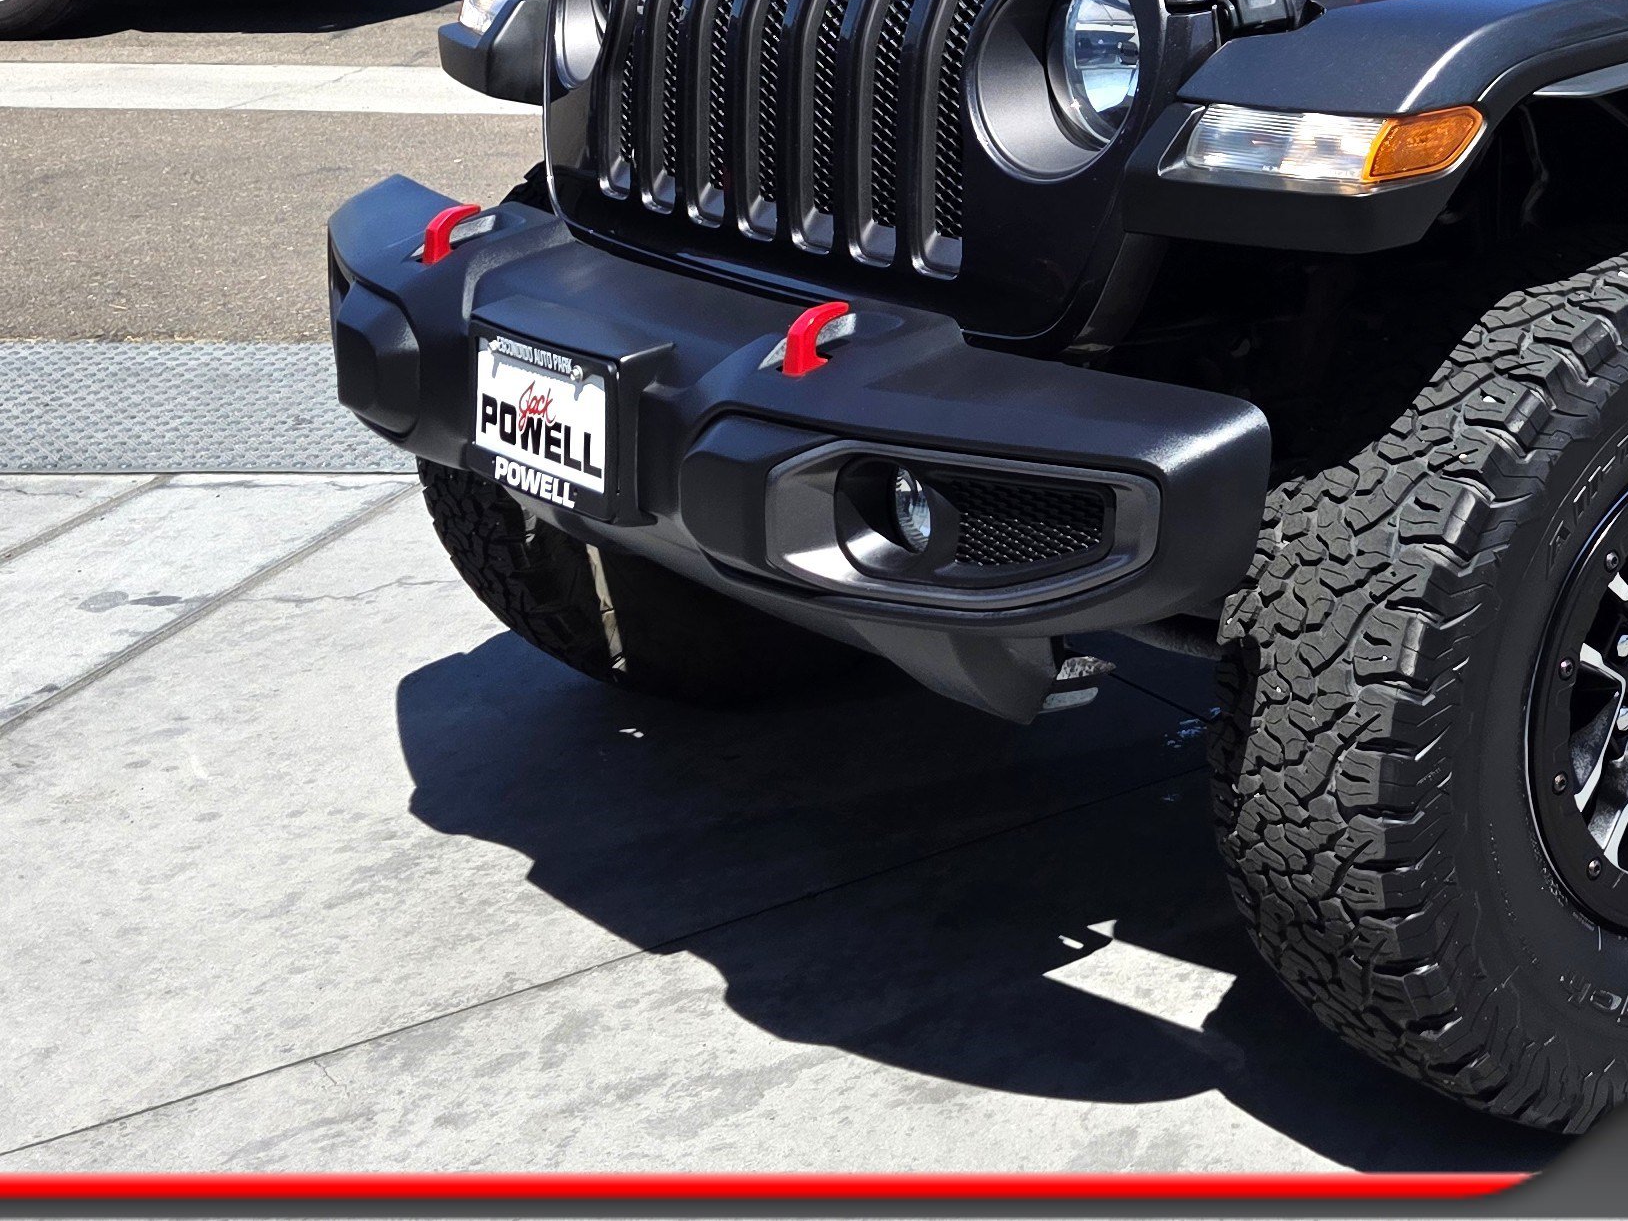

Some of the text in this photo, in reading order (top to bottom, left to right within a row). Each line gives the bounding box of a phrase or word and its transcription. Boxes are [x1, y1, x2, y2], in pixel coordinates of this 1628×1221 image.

[533, 348, 552, 369] AUTO
[553, 354, 573, 374] PARK
[518, 380, 556, 431] Jack
[481, 393, 602, 479] POWELL
[494, 456, 576, 509] POWELL
